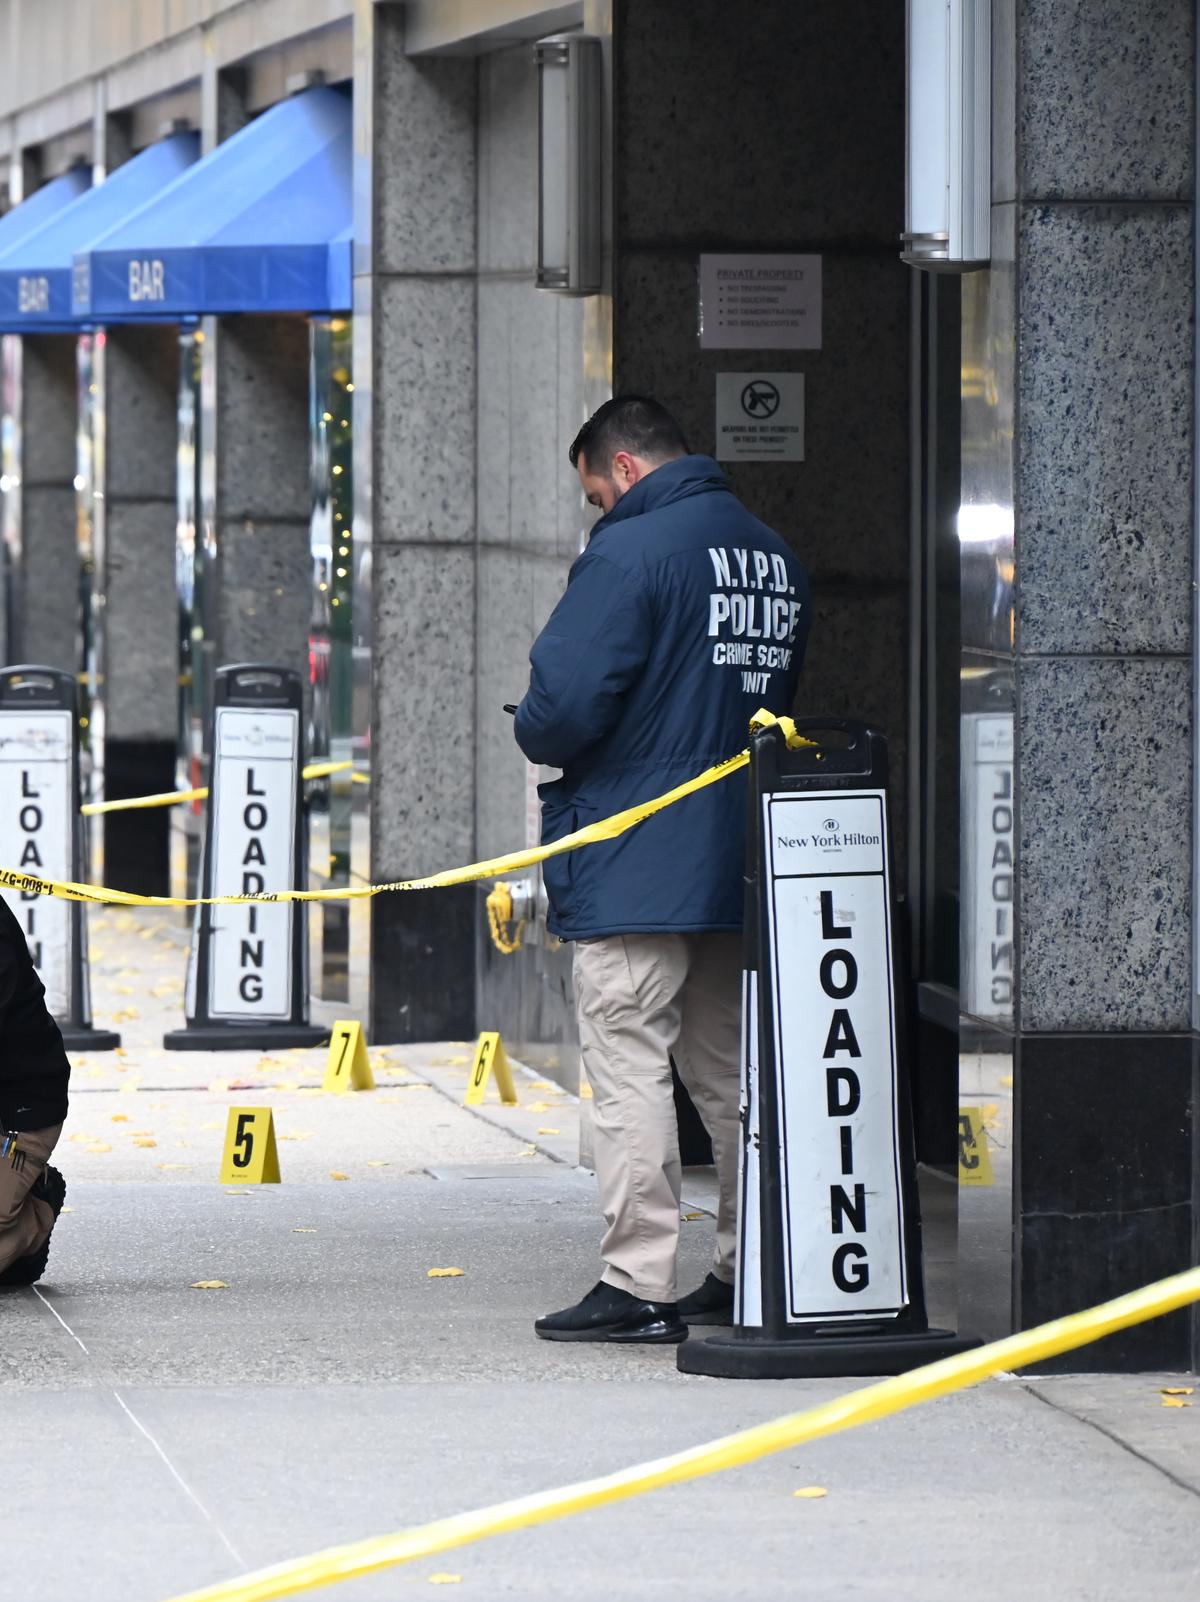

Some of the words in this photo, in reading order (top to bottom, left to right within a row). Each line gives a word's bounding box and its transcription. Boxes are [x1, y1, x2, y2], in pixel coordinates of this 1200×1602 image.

[18, 277, 49, 313] BAR
[129, 260, 165, 301] BAR
[716, 269, 754, 280] PRIVATE
[758, 269, 804, 280] PROPERTY
[708, 547, 795, 595] N.Y.P.D.
[708, 593, 801, 643] POLICE
[712, 642, 753, 665] CRIME
[778, 836, 809, 848] New
[811, 833, 841, 847] York
[843, 832, 880, 846] Hilton
[239, 768, 268, 1003] LOADING
[336, 1032, 351, 1076] 7
[475, 1040, 490, 1087] 6
[819, 890, 870, 1294] LOADING
[232, 1114, 255, 1168] 5
